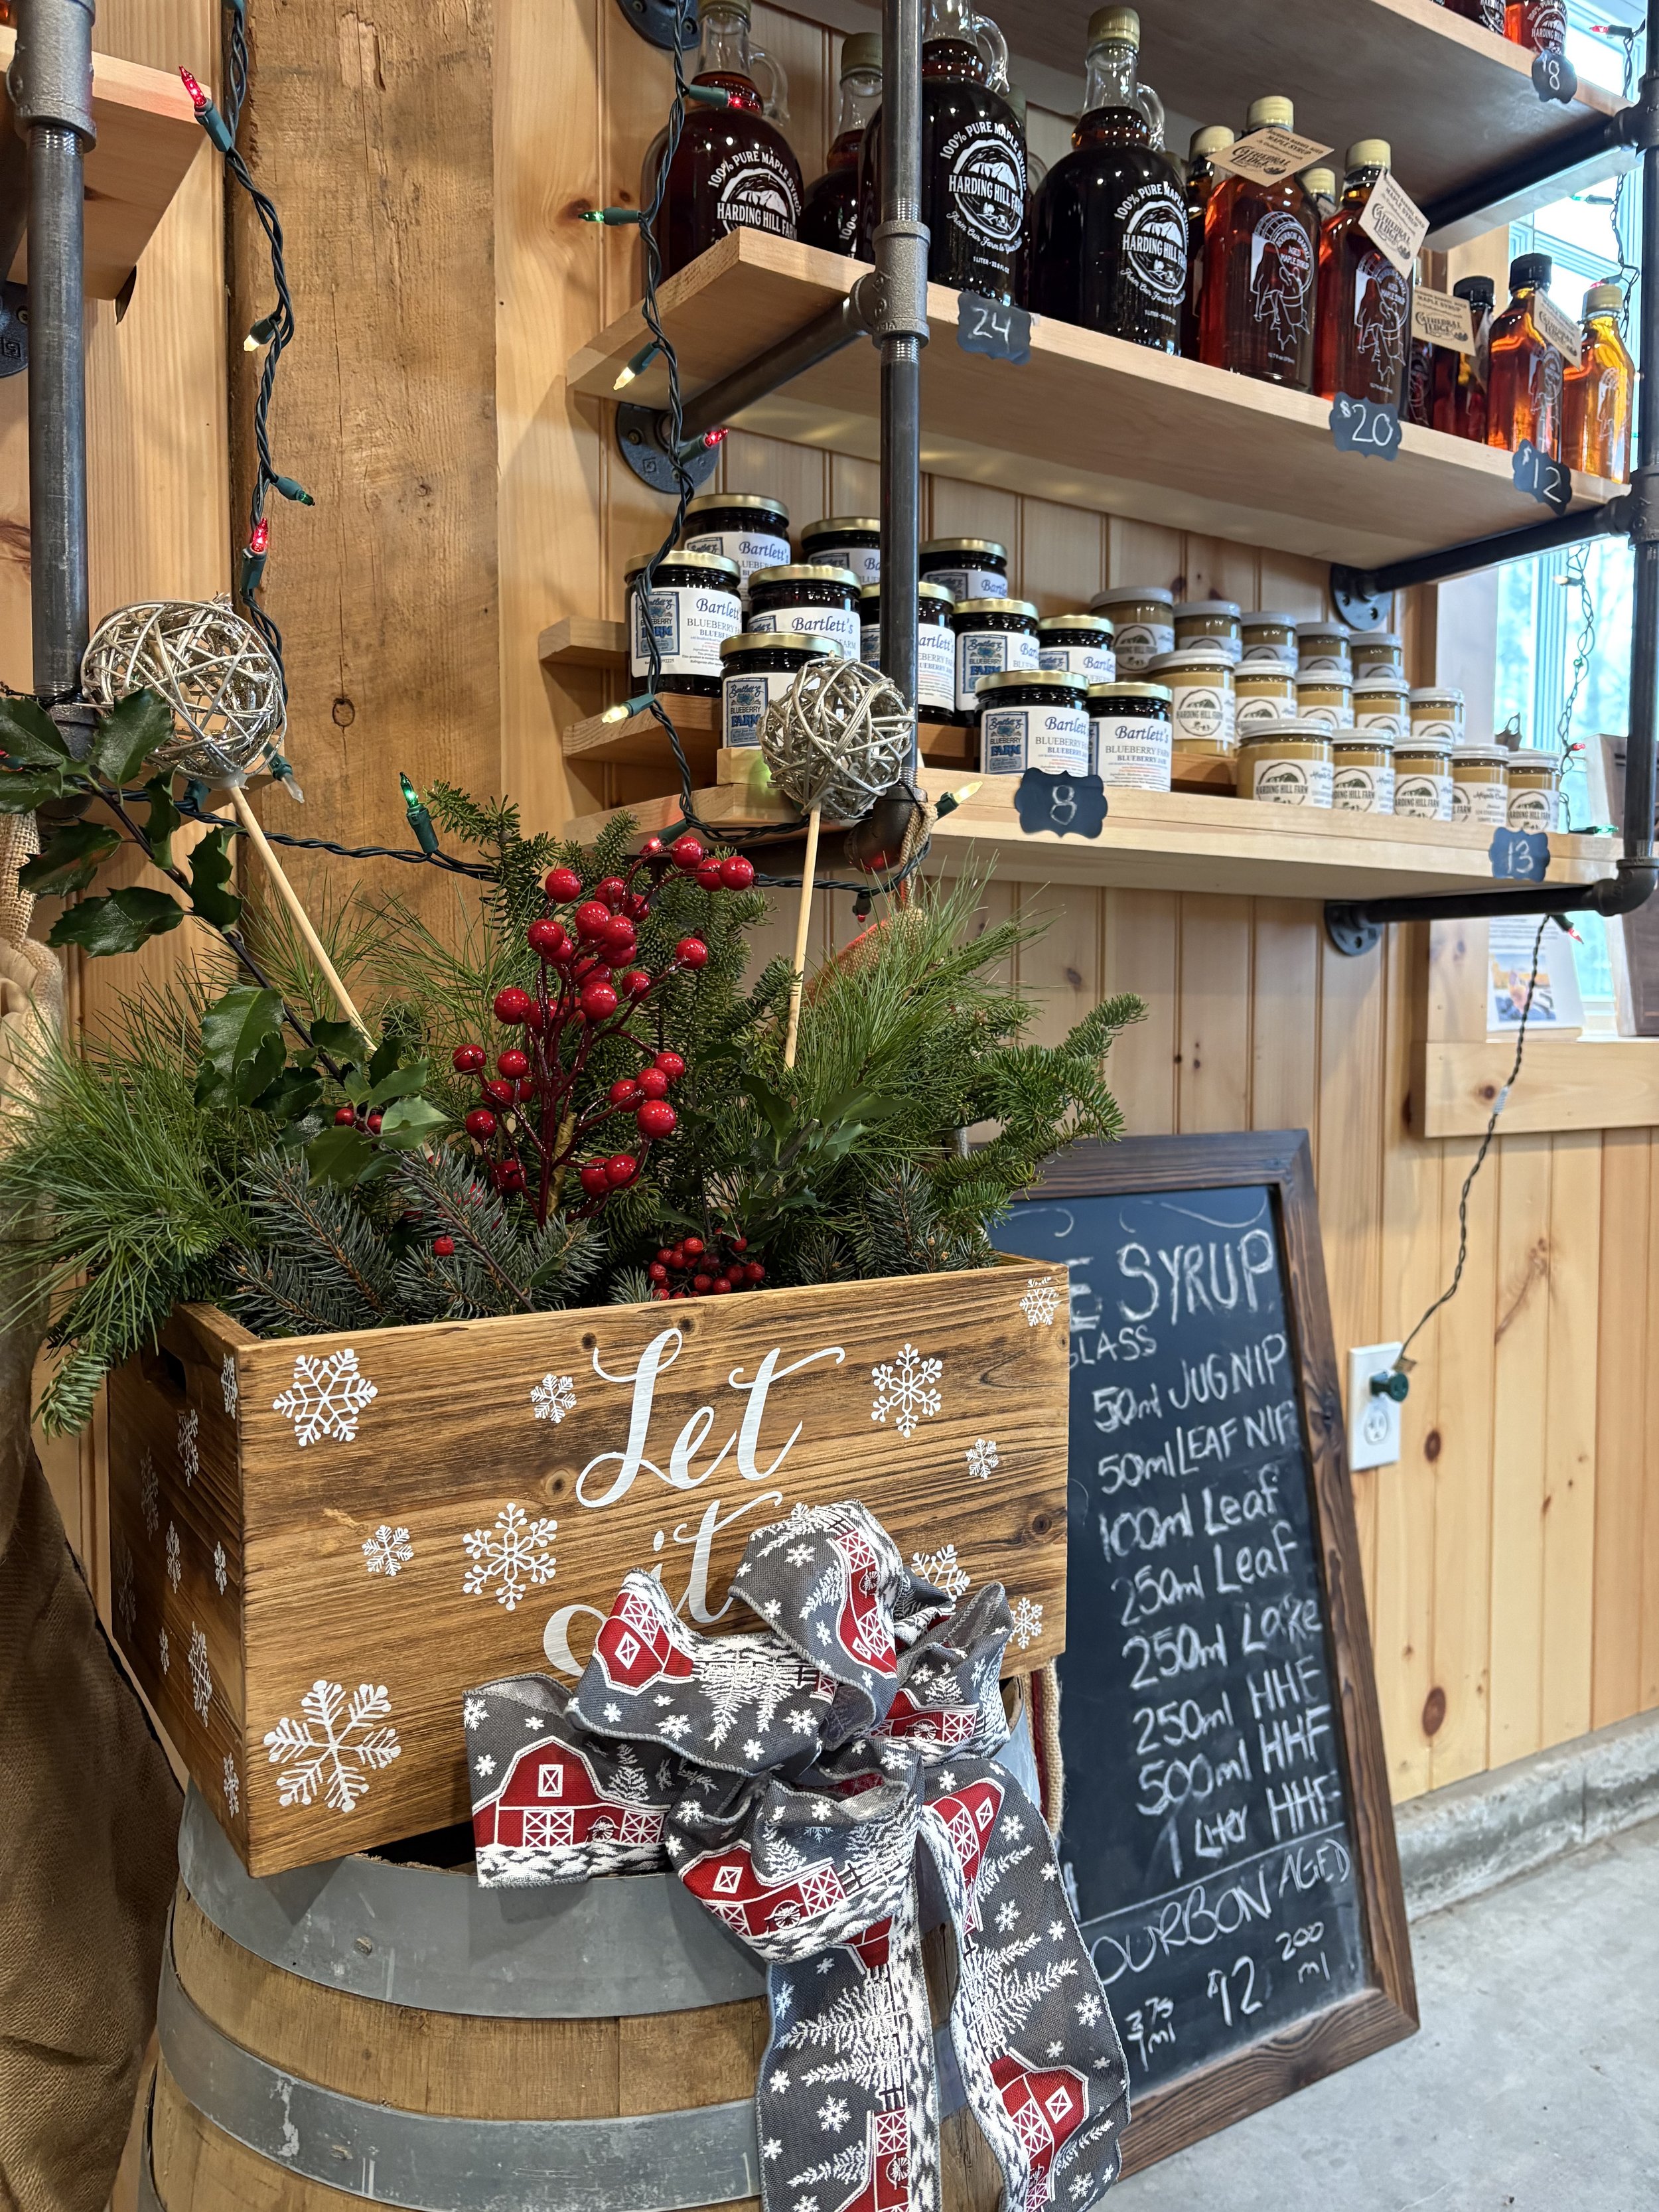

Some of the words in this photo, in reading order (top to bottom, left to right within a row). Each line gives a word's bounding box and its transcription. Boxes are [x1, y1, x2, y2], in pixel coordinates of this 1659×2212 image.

[940, 131, 967, 159] 100%
[965, 121, 993, 137] PURE
[994, 123, 1019, 152] MAPLE
[707, 161, 734, 188] 100%
[732, 151, 760, 166] PURE
[762, 152, 789, 178] MAPLE
[948, 175, 993, 198] HARDING
[994, 183, 1010, 207] HILL
[1114, 194, 1139, 220] 100%
[1137, 184, 1163, 199] PURE
[717, 202, 761, 225] HARDING
[763, 211, 780, 232] HILL
[946, 210, 967, 232] From
[1122, 234, 1163, 256] HARDING
[1163, 242, 1177, 263] HILL
[971, 308, 1011, 353] 24
[1340, 400, 1393, 447] $20
[687, 618, 734, 632] BLUEBERRY
[792, 616, 853, 634] Bartlett's
[991, 745, 1021, 757] FARM
[1036, 737, 1080, 747] BLUEBERRY
[1106, 746, 1156, 755] BLUEBERRY
[1115, 726, 1169, 743] Bartlett's
[1049, 784, 1077, 825] 8
[1508, 840, 1534, 874] 13
[1117, 1228, 1275, 1324] SYRUP
[1169, 1353, 1228, 1410] JUG
[1230, 1333, 1287, 1394] NIP
[576, 1328, 845, 1508] Let
[1098, 1440, 1176, 1495] 50ml
[1176, 1417, 1238, 1475] LEAF
[1099, 1493, 1194, 1563] 100ml
[1202, 1463, 1279, 1537] Leaf
[1111, 1564, 1206, 1627] 250ml
[1213, 1520, 1298, 1595] Leaf
[1122, 1623, 1228, 1690] 250ml
[1131, 1690, 1235, 1755] 250ml
[1135, 1737, 1253, 1816] 500ml
[1259, 1704, 1331, 1775] HHF
[1265, 1770, 1341, 1842] HHF
[1090, 1865, 1272, 1986] OURBON
[1279, 1838, 1351, 1898] AGED
[1275, 1921, 1325, 1962] 200
[1298, 1951, 1331, 1984] ml
